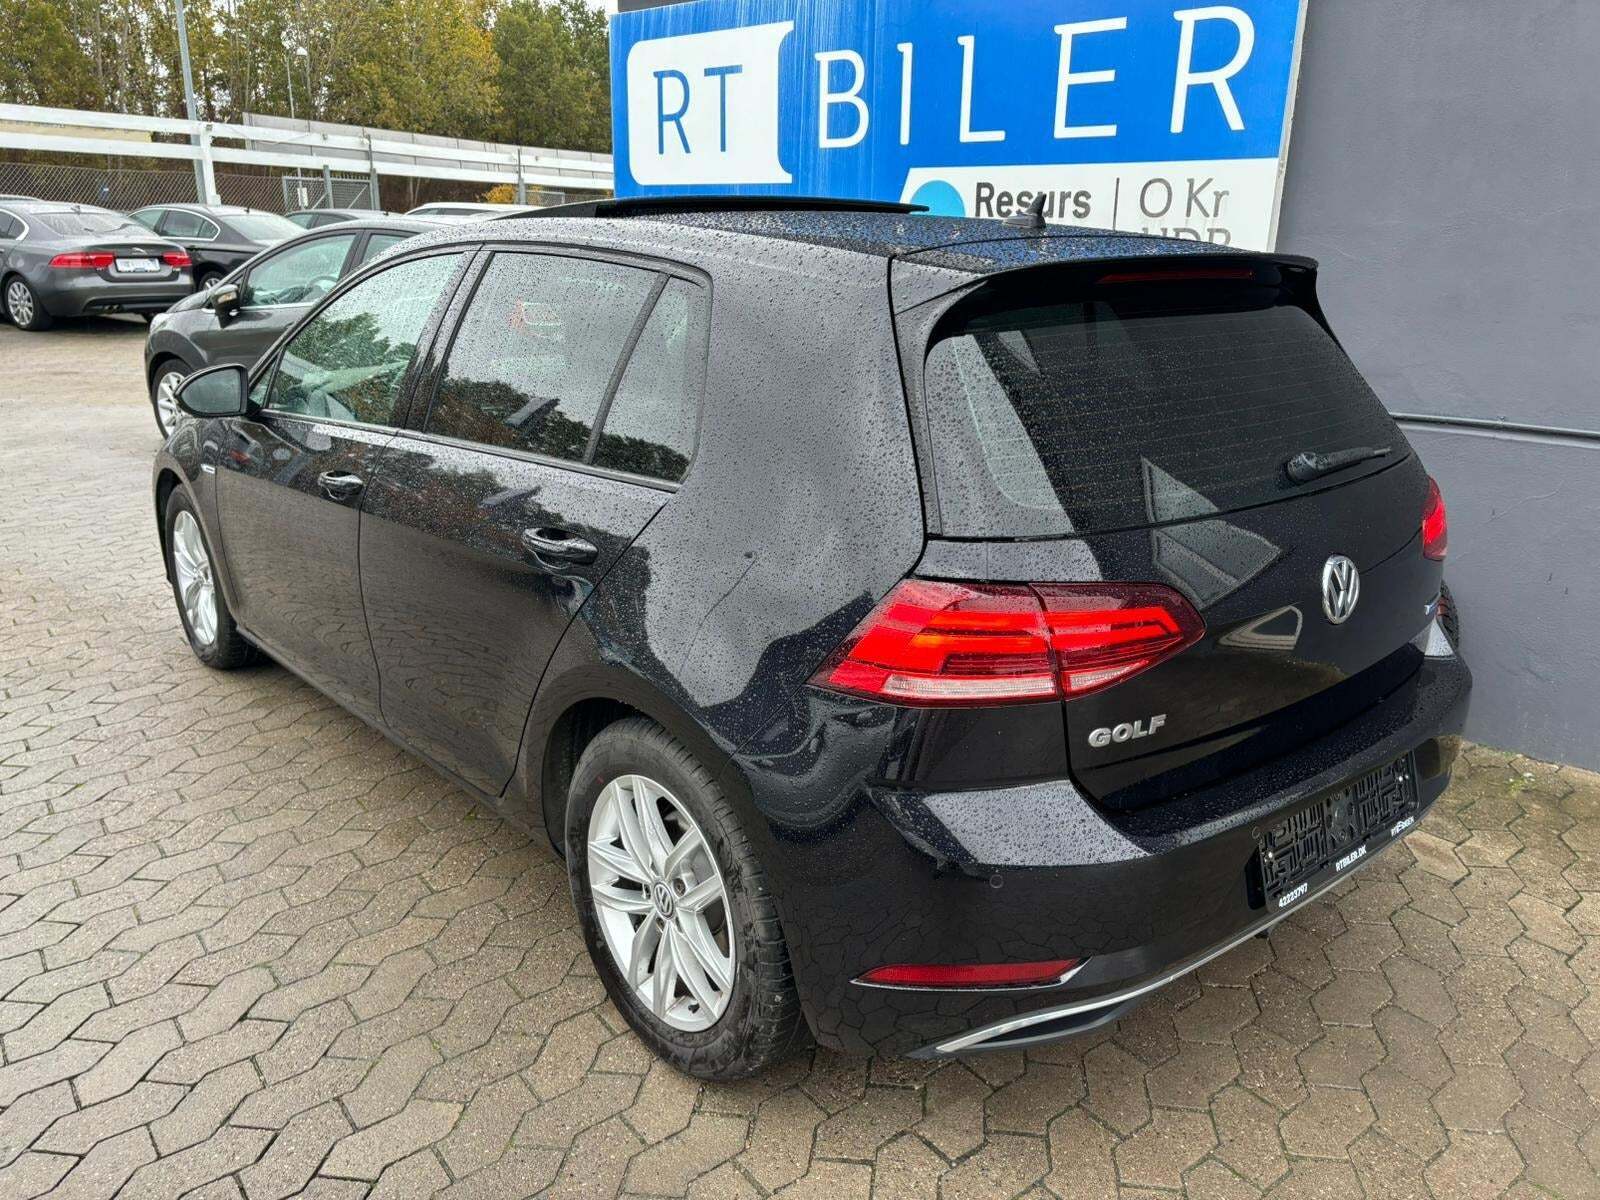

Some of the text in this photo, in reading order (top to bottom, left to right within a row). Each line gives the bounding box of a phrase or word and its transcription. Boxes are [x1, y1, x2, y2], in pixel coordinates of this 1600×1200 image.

[652, 5, 1256, 155] RT BILER
[974, 181, 1092, 219] Resurs
[1185, 177, 1230, 219] Kr
[1087, 713, 1167, 748] GOLF
[1278, 882, 1308, 908] 42223797
